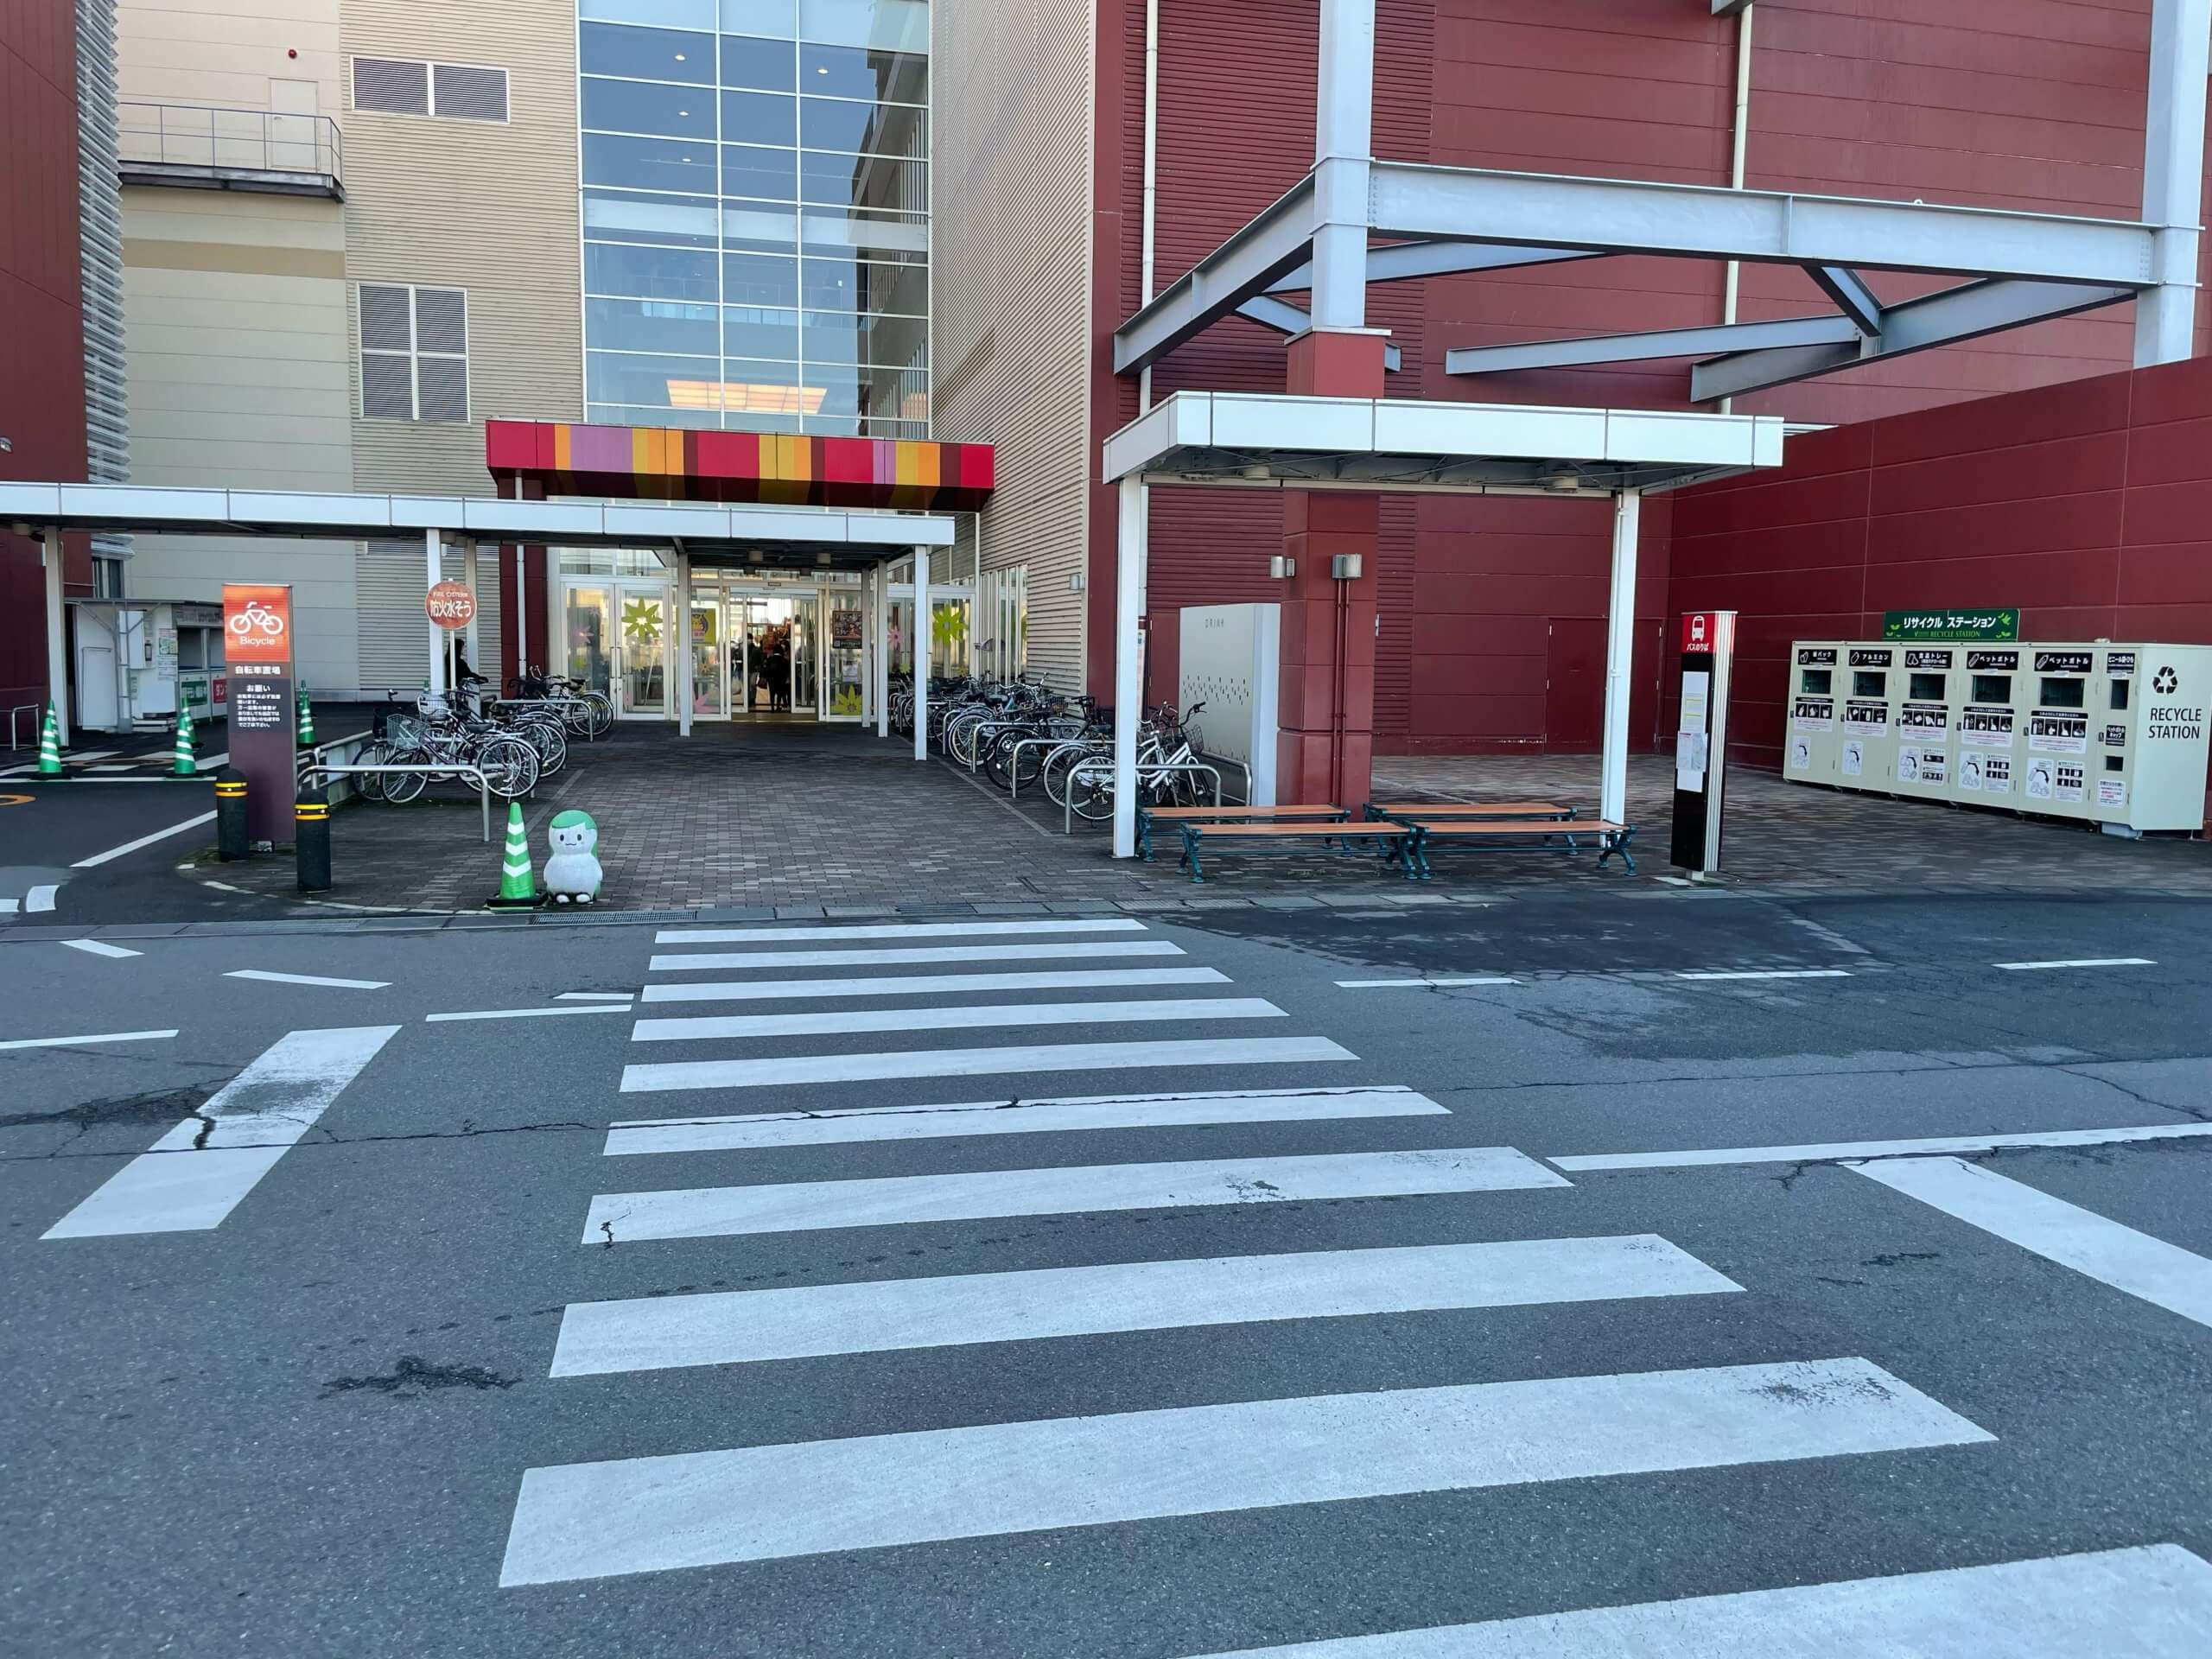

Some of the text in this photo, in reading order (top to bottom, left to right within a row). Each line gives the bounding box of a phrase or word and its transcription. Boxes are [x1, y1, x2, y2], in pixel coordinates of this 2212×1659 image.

[429, 599, 472, 618] 防火水そう
[1904, 617, 1996, 629] リサイクル ステーション
[239, 636, 276, 647] Bicycle
[246, 684, 271, 693] お願い
[2150, 708, 2202, 721] RECYCLE
[2148, 725, 2200, 740] STATION
